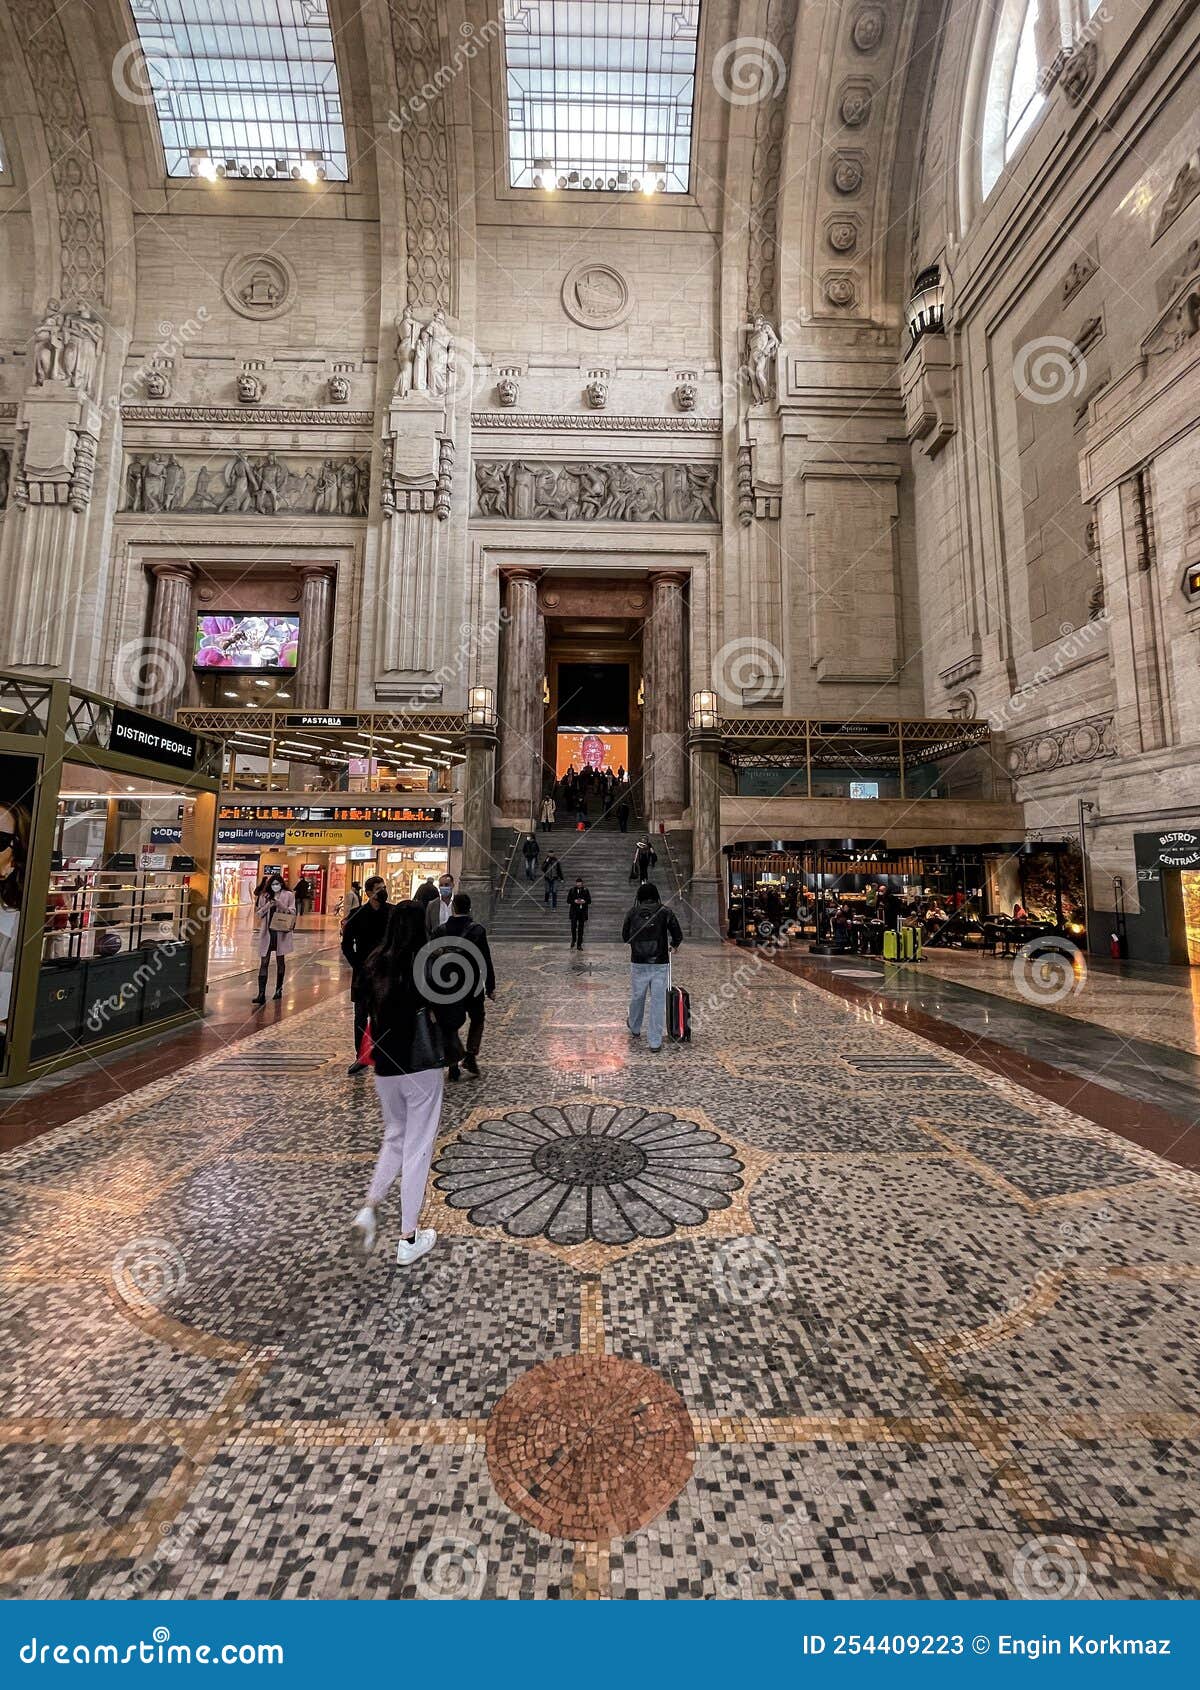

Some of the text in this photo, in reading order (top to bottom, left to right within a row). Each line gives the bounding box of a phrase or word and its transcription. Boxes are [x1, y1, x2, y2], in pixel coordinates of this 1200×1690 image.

[116, 725, 192, 757] DISTRICT PEOPLE
[1159, 833, 1198, 845] BISTROT
[1159, 851, 1200, 866] CENTRALE
